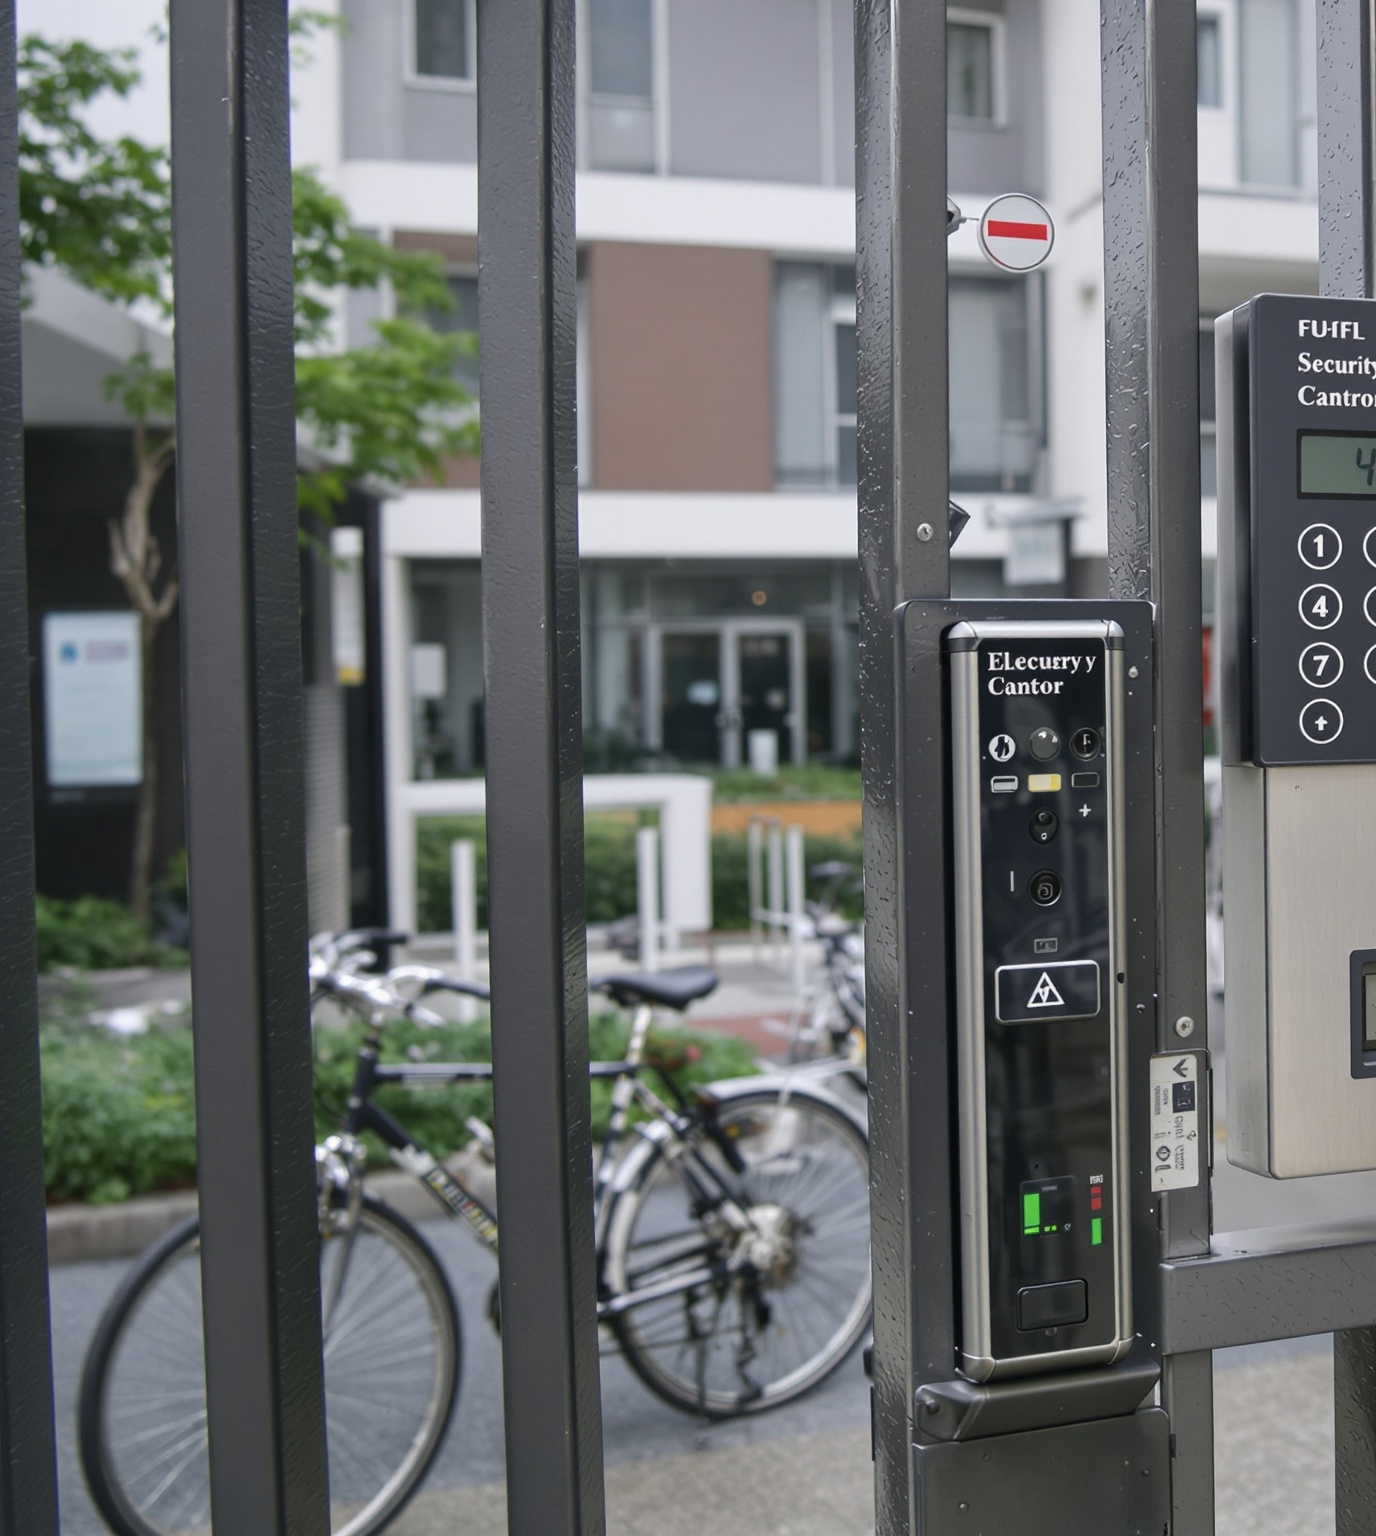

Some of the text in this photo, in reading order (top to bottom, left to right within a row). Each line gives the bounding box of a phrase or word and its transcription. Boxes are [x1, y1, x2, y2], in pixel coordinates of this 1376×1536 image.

[1313, 534, 1325, 558] 1
[1312, 595, 1329, 618] 4
[1312, 655, 1330, 677] 7
[987, 676, 1064, 696] Cantor
